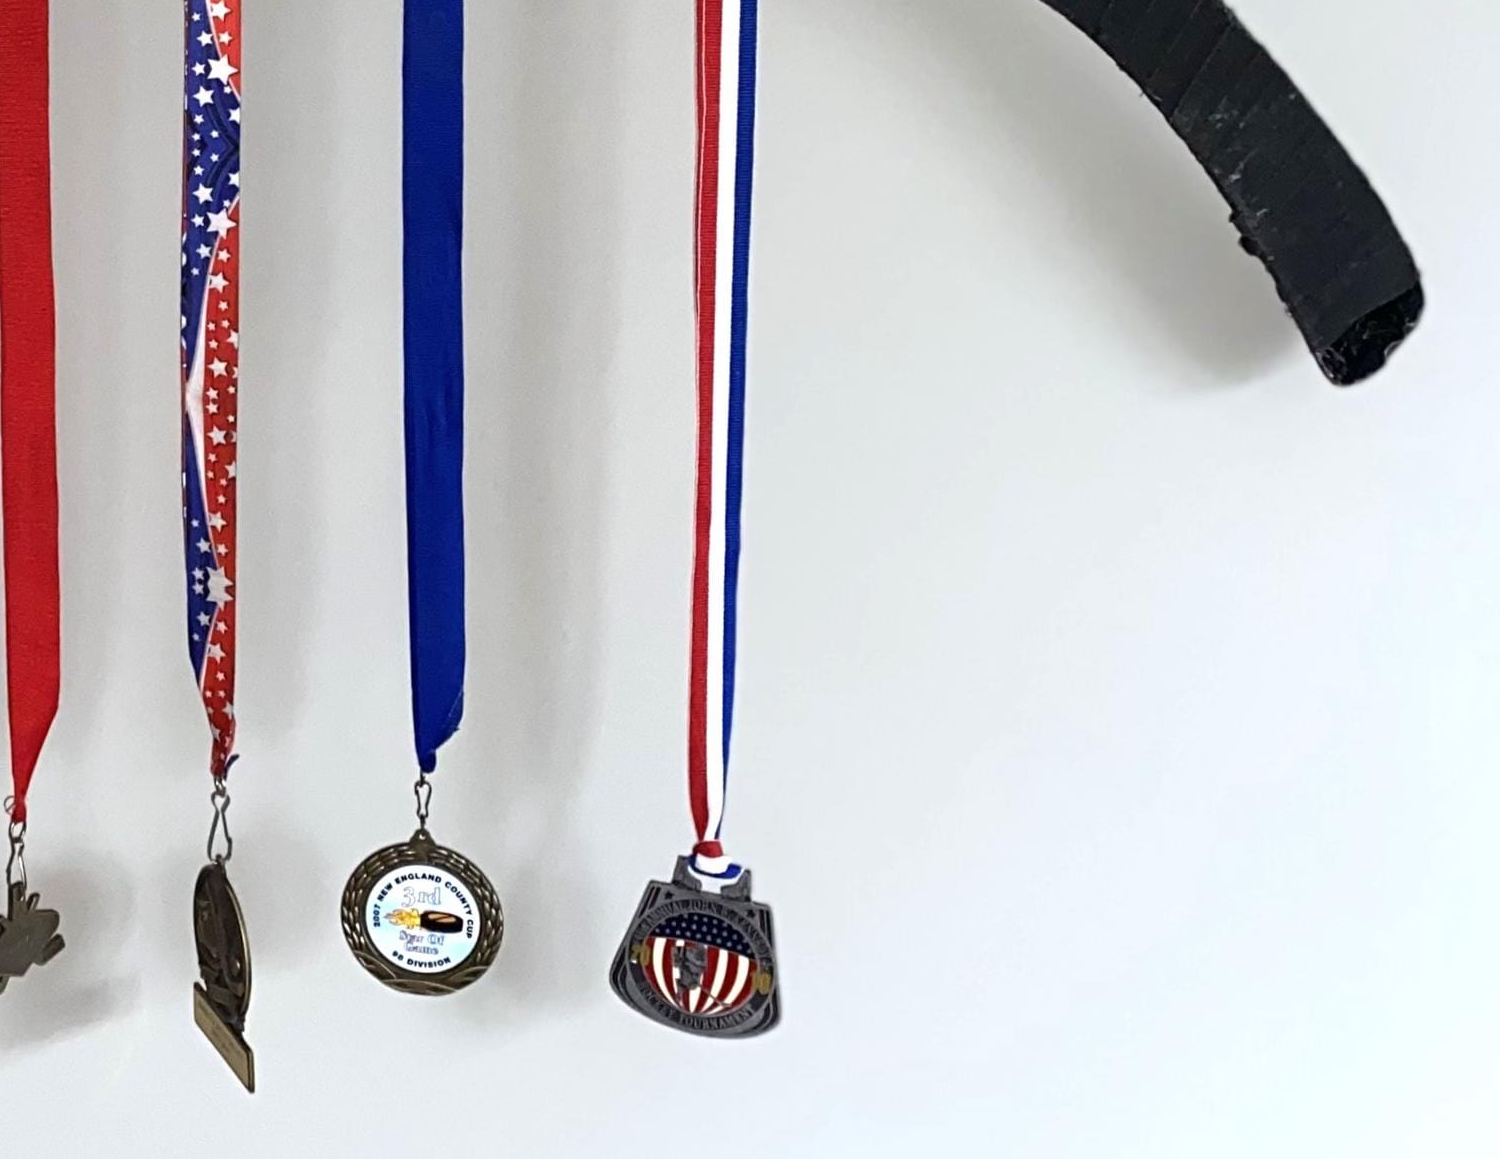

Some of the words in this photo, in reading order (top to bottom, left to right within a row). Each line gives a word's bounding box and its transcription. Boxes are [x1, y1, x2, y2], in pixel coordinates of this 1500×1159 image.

[377, 883, 393, 902] NEW
[394, 872, 442, 885] ENGLAND
[444, 881, 473, 916] COUNTY
[466, 919, 474, 940] CUP
[401, 886, 442, 908] 3rd
[406, 956, 451, 969] DIVISION
